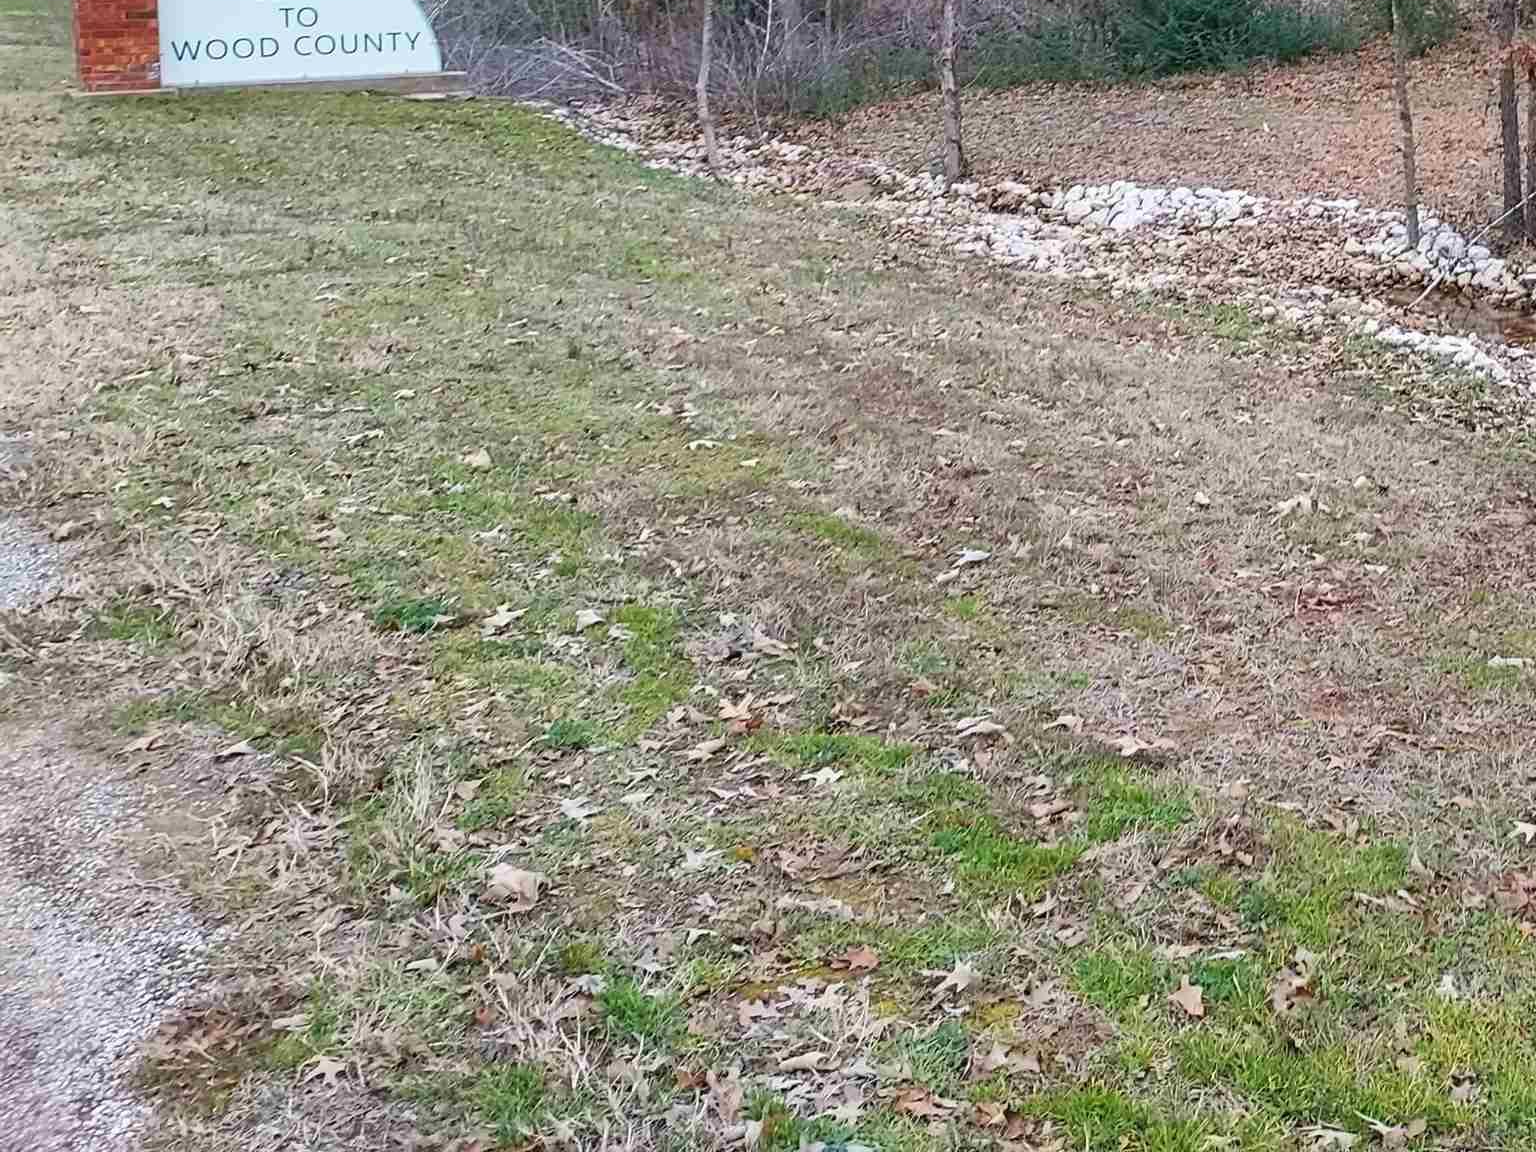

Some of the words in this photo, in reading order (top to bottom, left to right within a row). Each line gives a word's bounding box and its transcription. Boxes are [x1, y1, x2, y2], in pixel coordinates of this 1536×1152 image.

[279, 6, 319, 28] TO
[170, 37, 280, 62] WOOD
[293, 31, 421, 57] COUNTY
